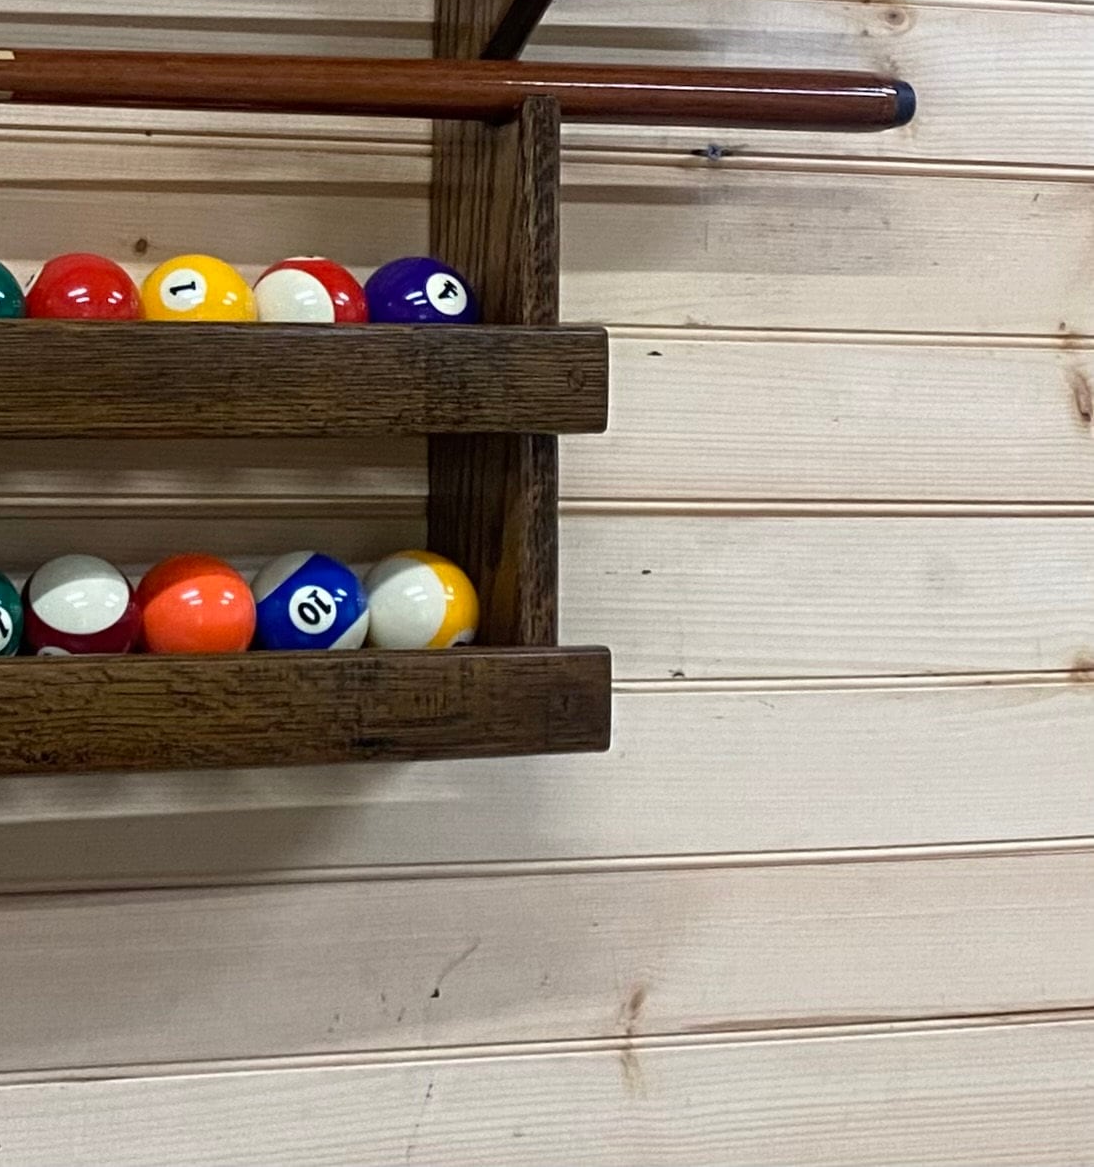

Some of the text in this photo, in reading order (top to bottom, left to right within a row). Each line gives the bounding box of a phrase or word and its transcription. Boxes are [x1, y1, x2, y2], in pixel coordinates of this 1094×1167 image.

[169, 280, 196, 296] 1
[438, 279, 458, 300] 4
[297, 589, 332, 626] 10
